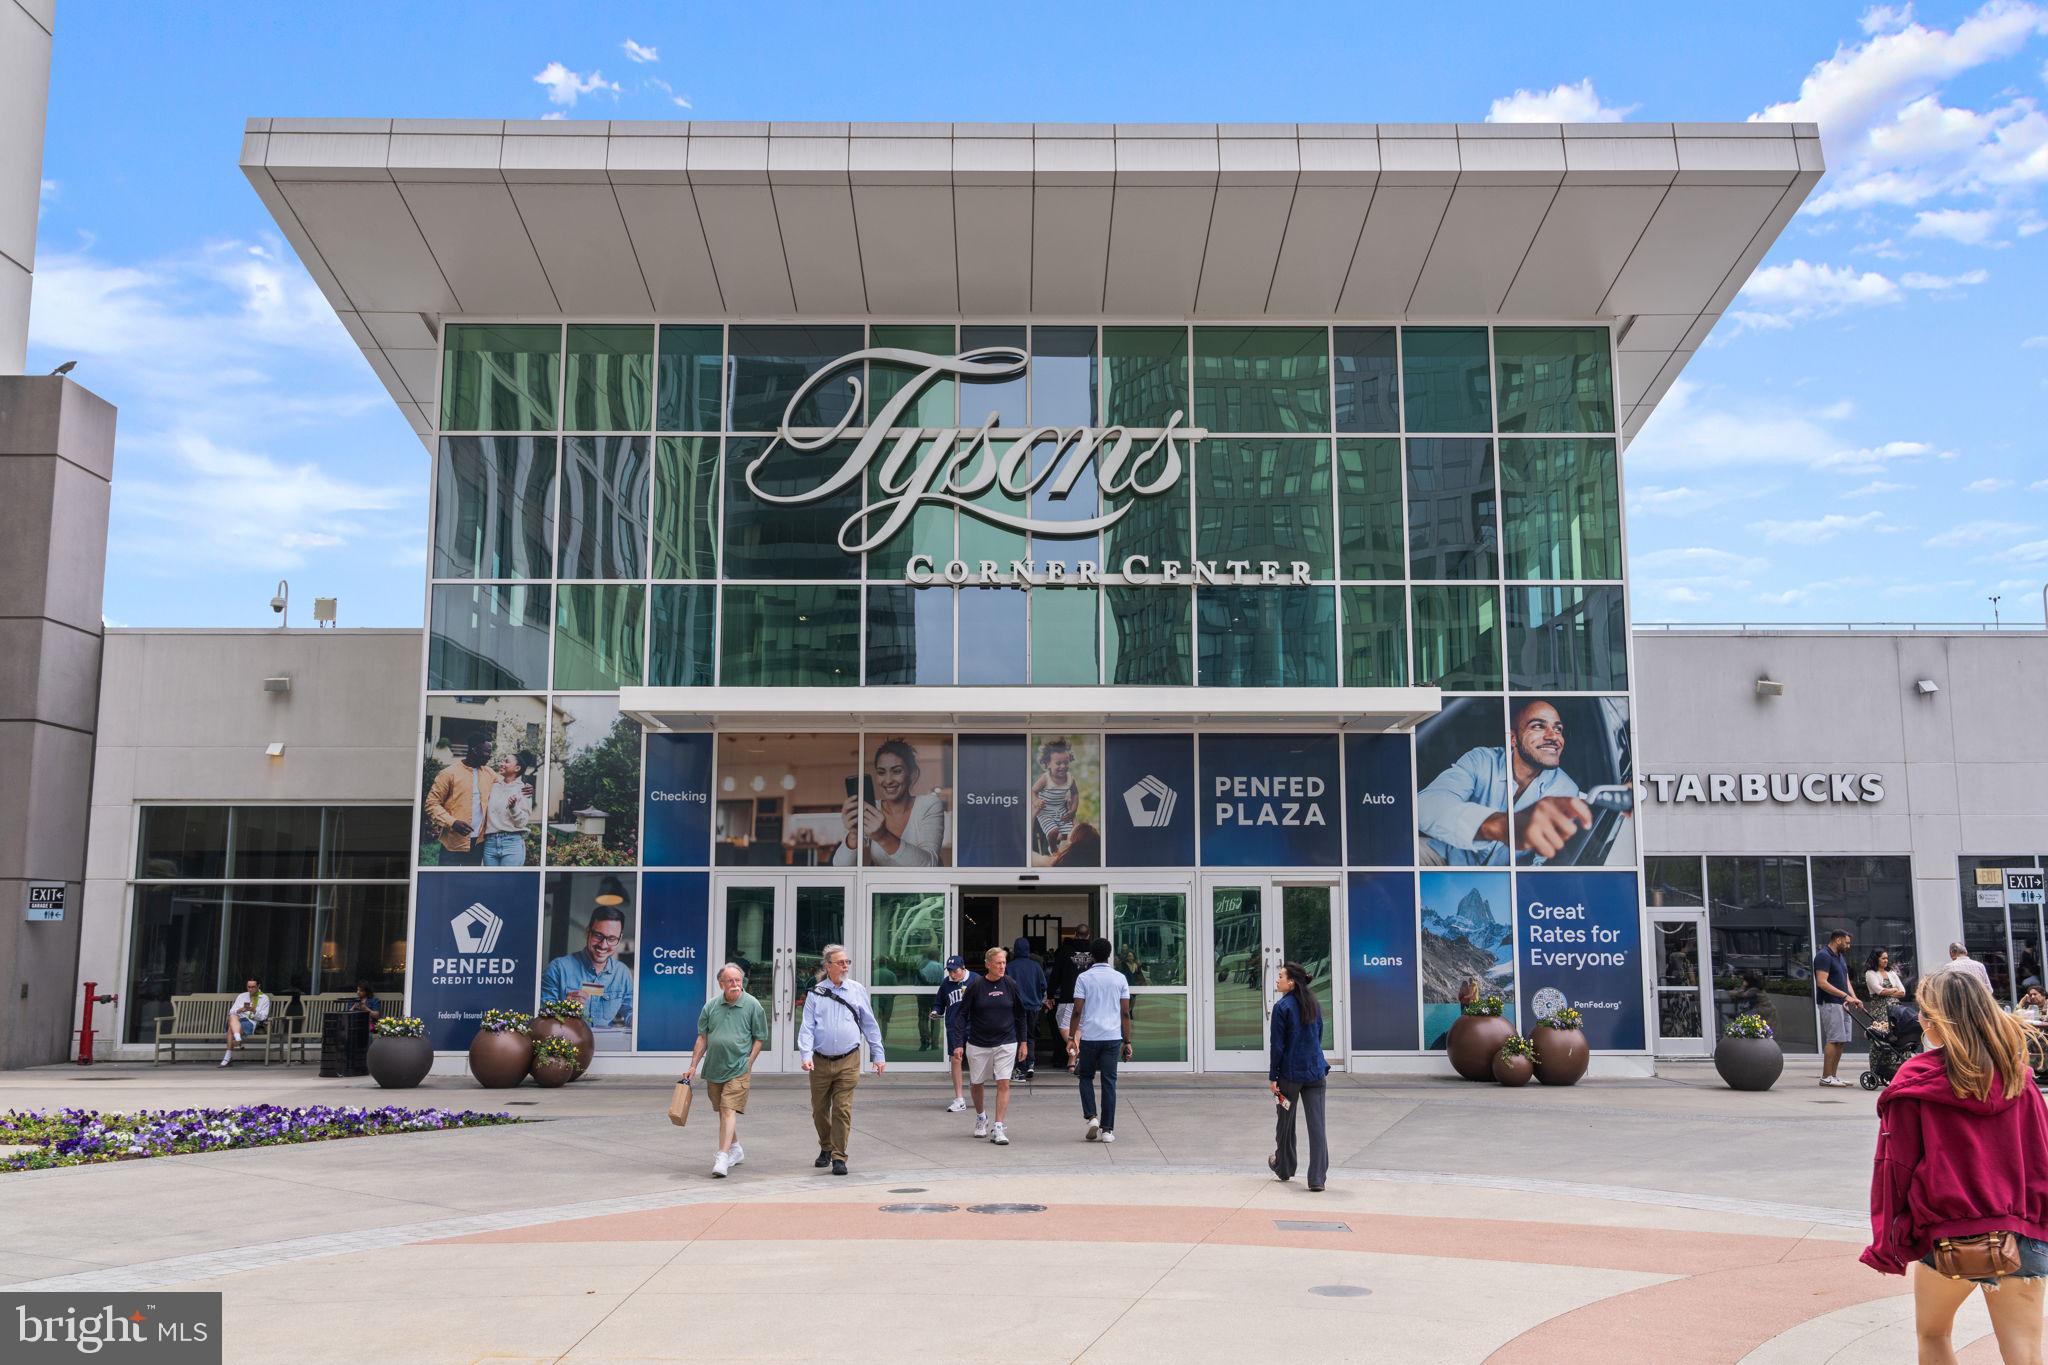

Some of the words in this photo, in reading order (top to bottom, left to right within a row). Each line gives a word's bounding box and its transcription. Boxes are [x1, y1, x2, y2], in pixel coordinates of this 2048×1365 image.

[745, 346, 1184, 553] Tysons
[906, 554, 1100, 585] CORNER
[1123, 554, 1312, 585] CENTER
[1215, 776, 1325, 797] PENFED
[650, 790, 707, 804] Checking
[966, 792, 1019, 808] Savings
[1362, 792, 1395, 805] Auto
[1216, 802, 1326, 826] PLAZA
[2009, 875, 2035, 889] EXIT
[32, 888, 58, 901] EXIT
[1528, 901, 1586, 920] Great
[1530, 925, 1586, 943] Rates
[1591, 925, 1621, 943] for
[652, 946, 696, 959] Credit
[1363, 953, 1403, 966] Loans
[1530, 948, 1625, 971] Everyone
[432, 958, 516, 974] PENFED
[653, 962, 694, 975] Cards
[431, 976, 473, 985] CREDIT
[477, 976, 514, 985] UNION
[1574, 1001, 1620, 1010] PenFed.org
[438, 1010, 461, 1021] Federally
[463, 1010, 483, 1020] Insured
